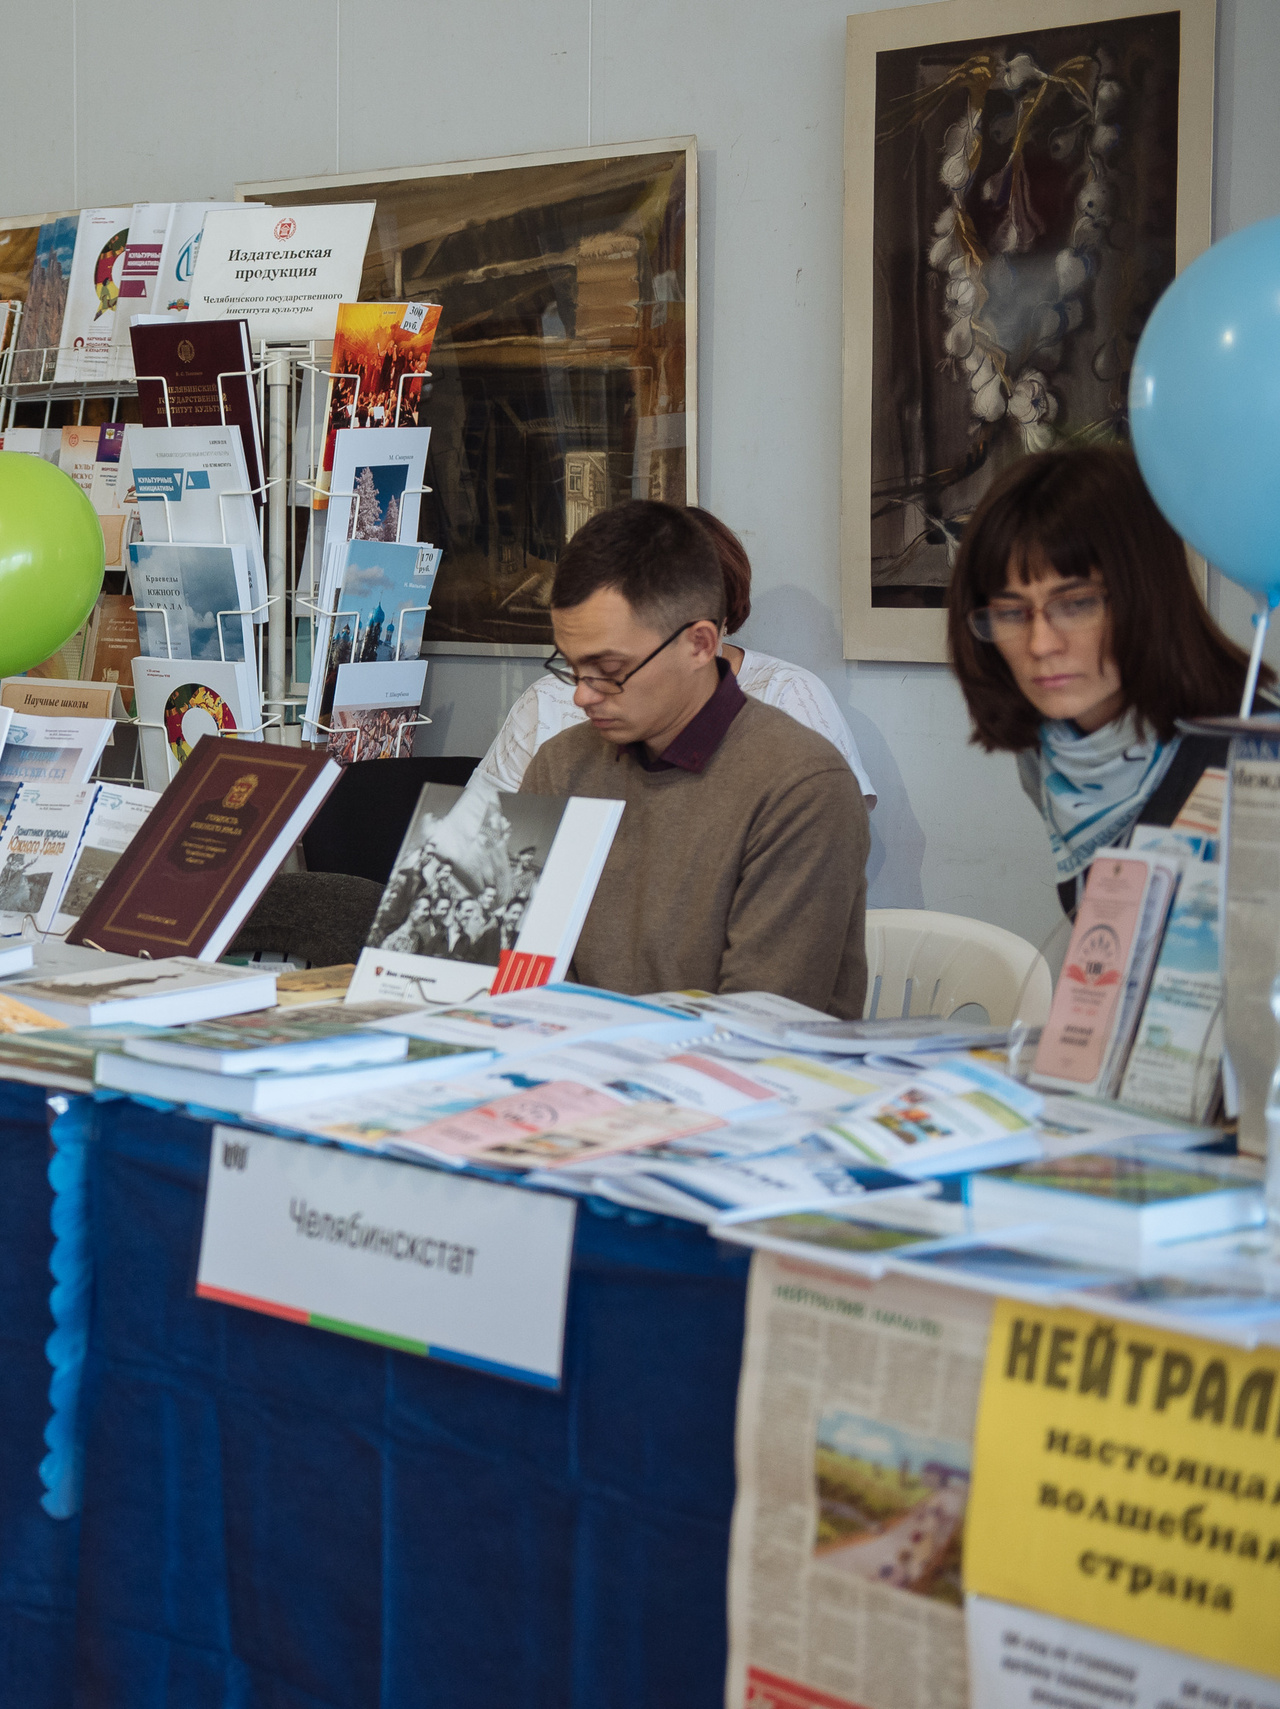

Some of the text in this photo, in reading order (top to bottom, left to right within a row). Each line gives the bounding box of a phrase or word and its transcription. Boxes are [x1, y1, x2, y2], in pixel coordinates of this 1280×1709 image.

[228, 248, 332, 263] Издательская
[235, 267, 317, 282] продукция
[203, 292, 343, 304] Челябинского государственного
[226, 306, 313, 315] института культуры
[138, 476, 173, 484] КУЛЬТУРНЫЕ
[139, 485, 174, 493] ИНИЦИАТИВЫ
[421, 553, 434, 562] 170
[145, 575, 178, 584] Краеведы
[147, 589, 181, 597] ЮЖНОГО
[149, 603, 183, 611] УРАЛА
[24, 694, 89, 710] Научные школы
[44, 829, 70, 840] природы
[7, 835, 66, 856] Южного Урала
[288, 1197, 478, 1278] Челябинскстат
[1005, 1316, 1280, 1440] НЕЙТРАЛ
[1078, 1549, 1235, 1614] страна
